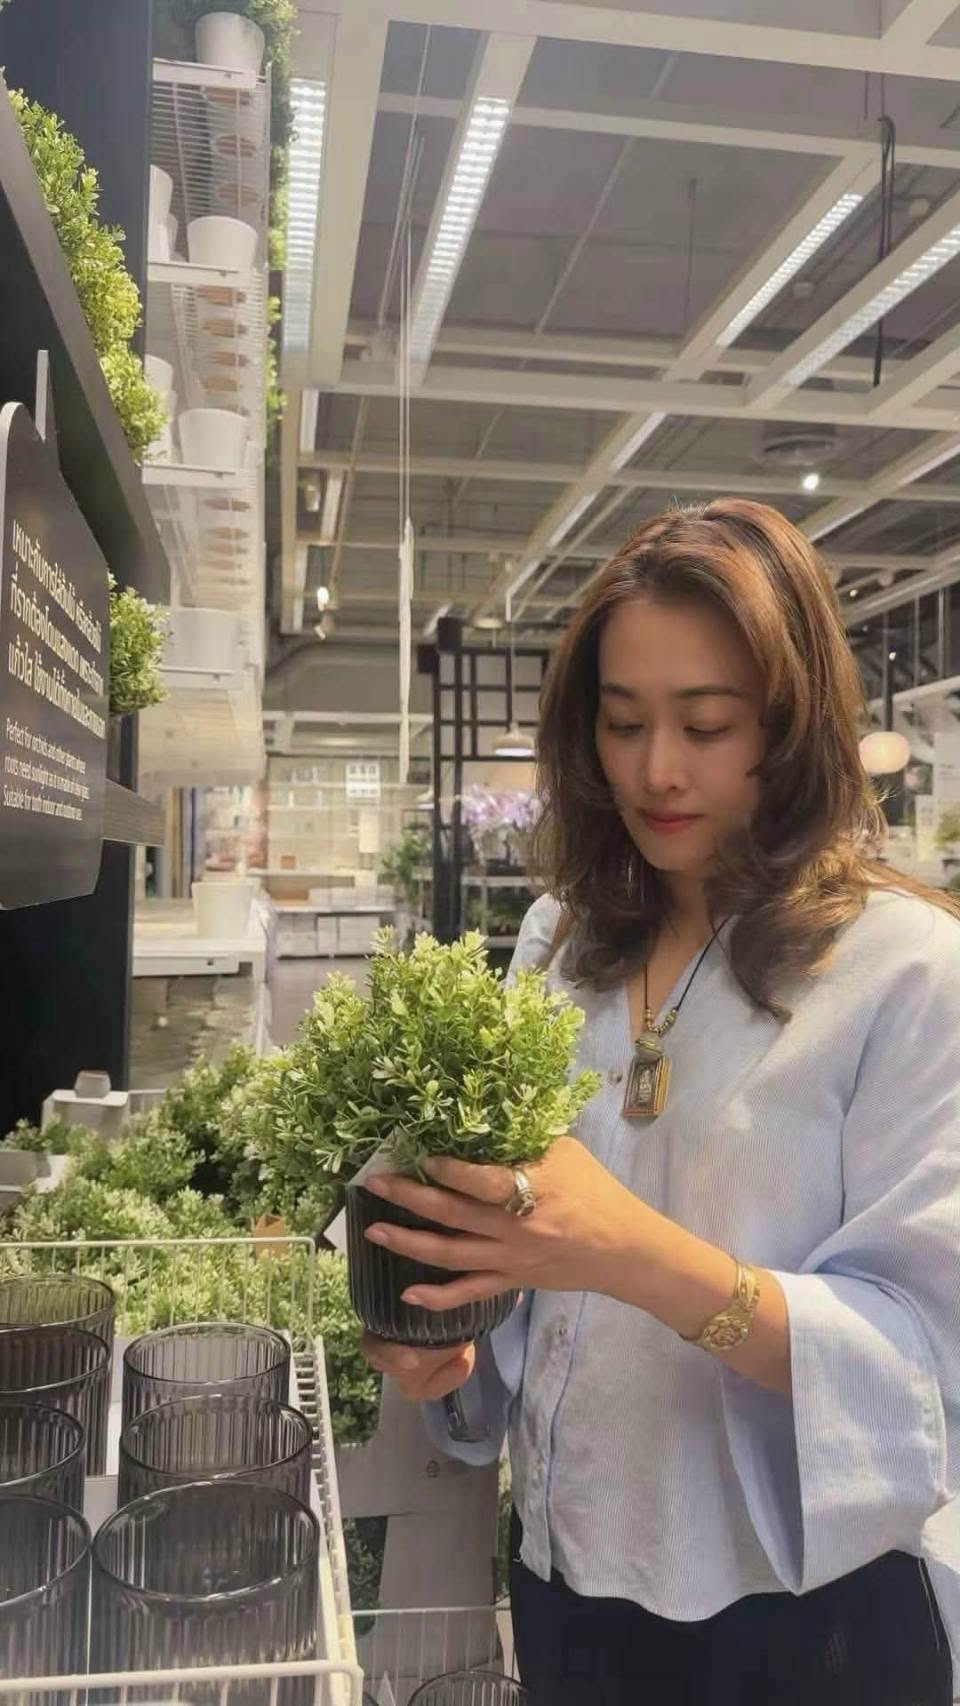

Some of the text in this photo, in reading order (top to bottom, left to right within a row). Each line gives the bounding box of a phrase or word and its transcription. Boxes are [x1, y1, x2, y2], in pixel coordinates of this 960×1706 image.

[6, 717, 23, 745] Perfect
[23, 726, 32, 749] for
[4, 754, 18, 775] roots
[18, 758, 31, 779] need
[3, 782, 24, 809] Suitable
[23, 787, 31, 810] for
